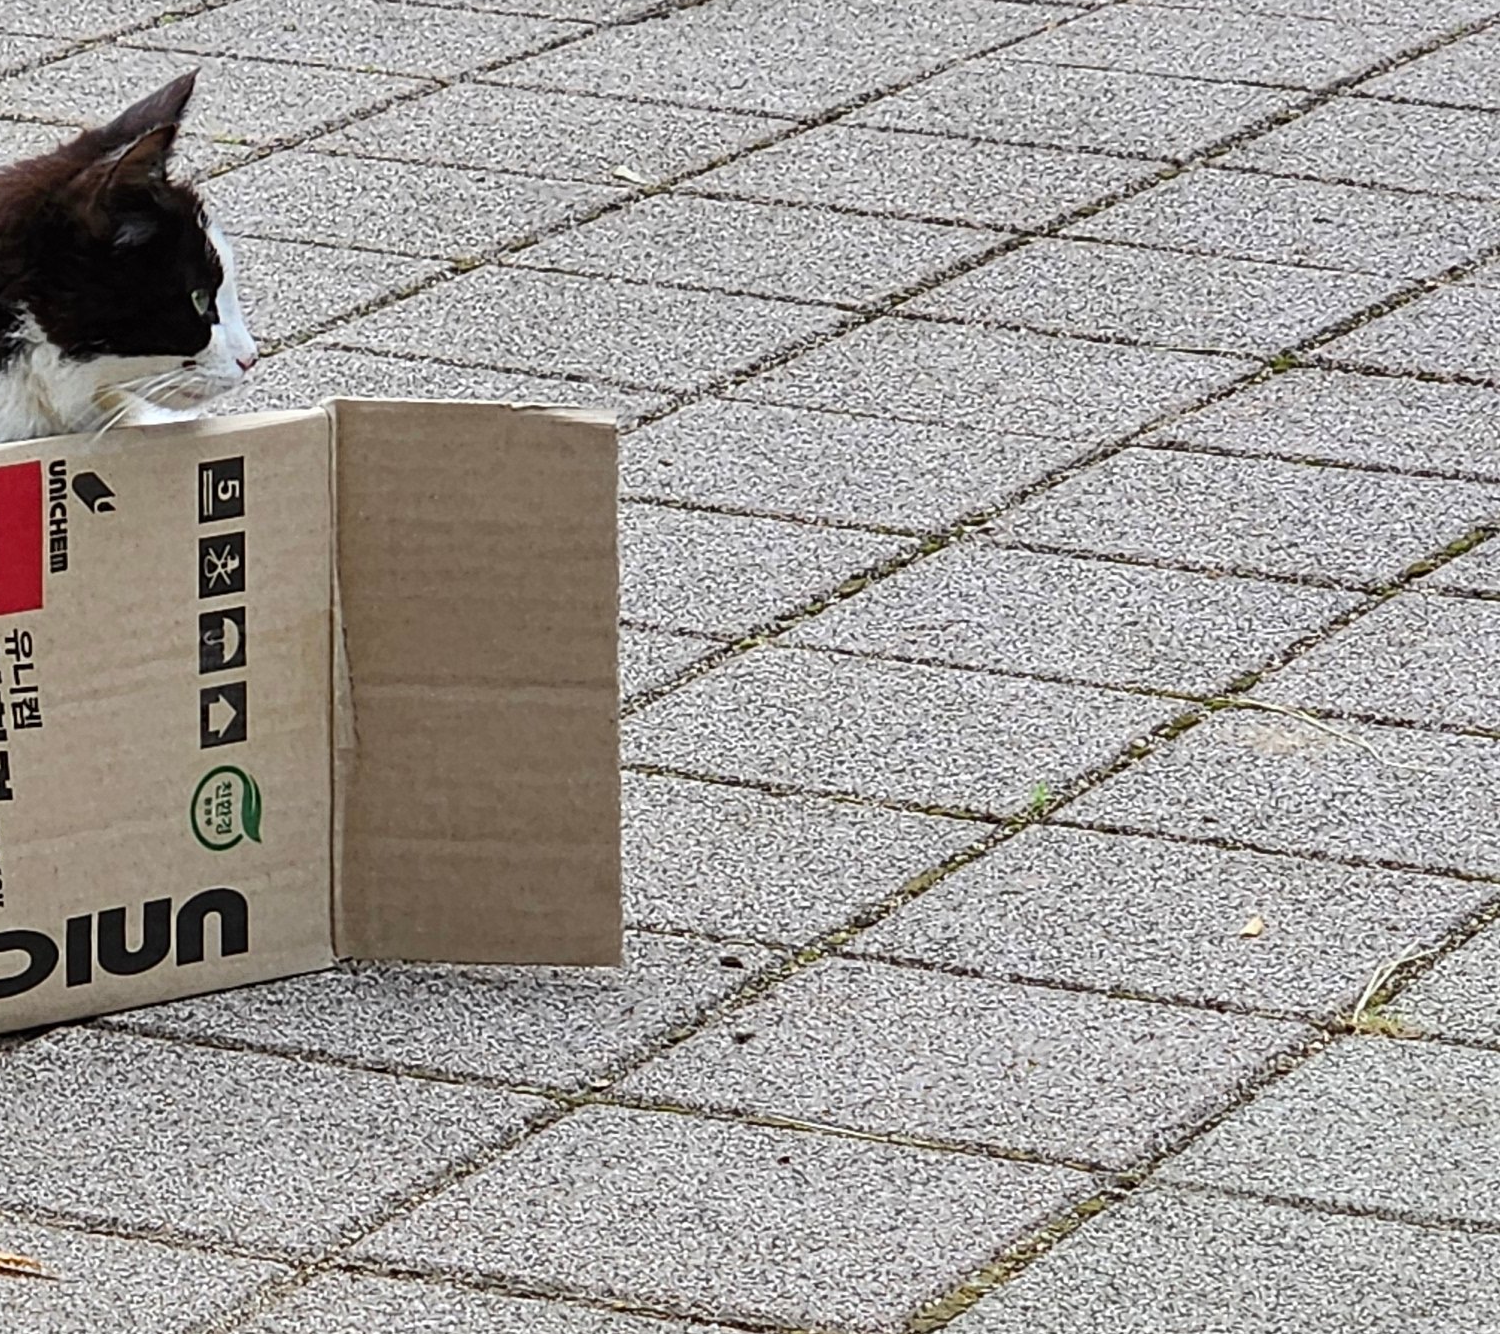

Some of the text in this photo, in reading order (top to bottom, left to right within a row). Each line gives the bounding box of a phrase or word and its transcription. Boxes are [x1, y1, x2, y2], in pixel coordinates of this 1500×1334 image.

[49, 460, 68, 573] UNICHEM
[218, 480, 240, 499] 5
[5, 629, 43, 730] 유니켐
[216, 781, 233, 835] 친환경
